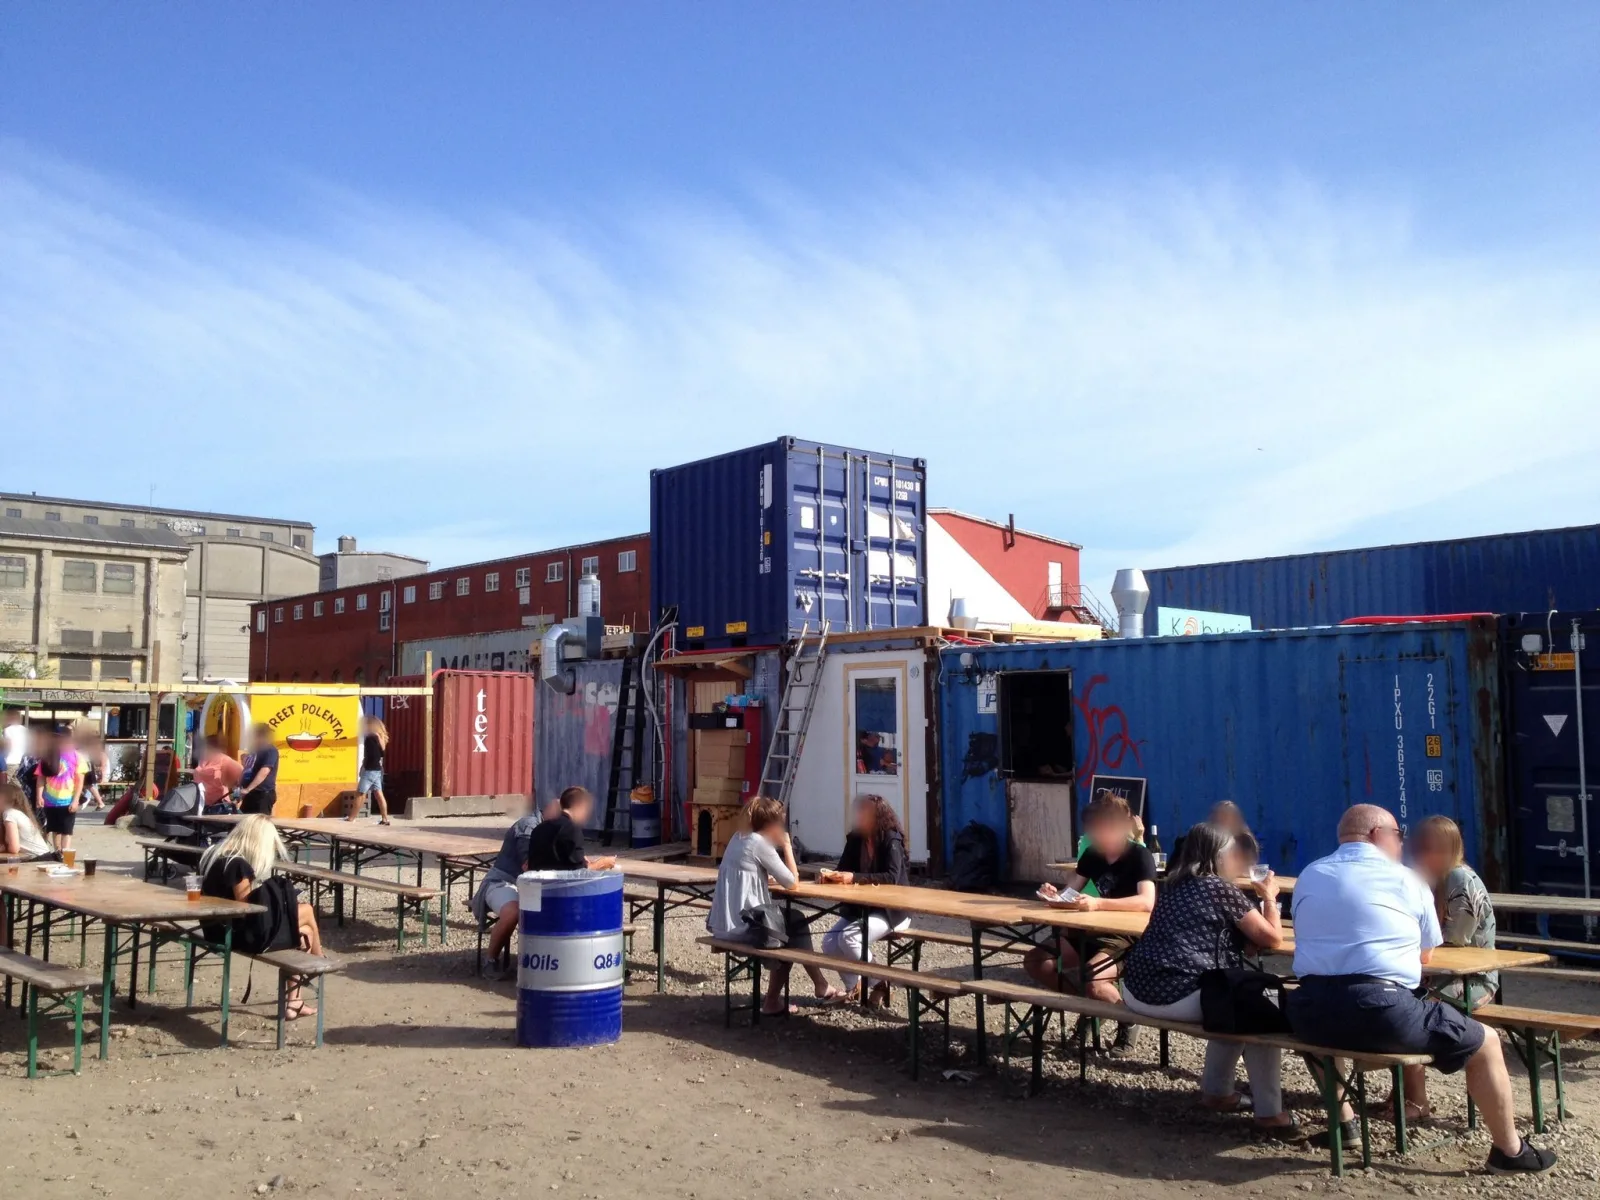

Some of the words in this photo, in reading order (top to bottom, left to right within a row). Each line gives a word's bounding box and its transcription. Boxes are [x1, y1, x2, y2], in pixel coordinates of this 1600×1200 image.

[268, 704, 295, 732] REET
[473, 688, 489, 753] tex
[1430, 783, 1442, 792] 83
[530, 953, 559, 971] Oils
[594, 953, 613, 970] Q8
